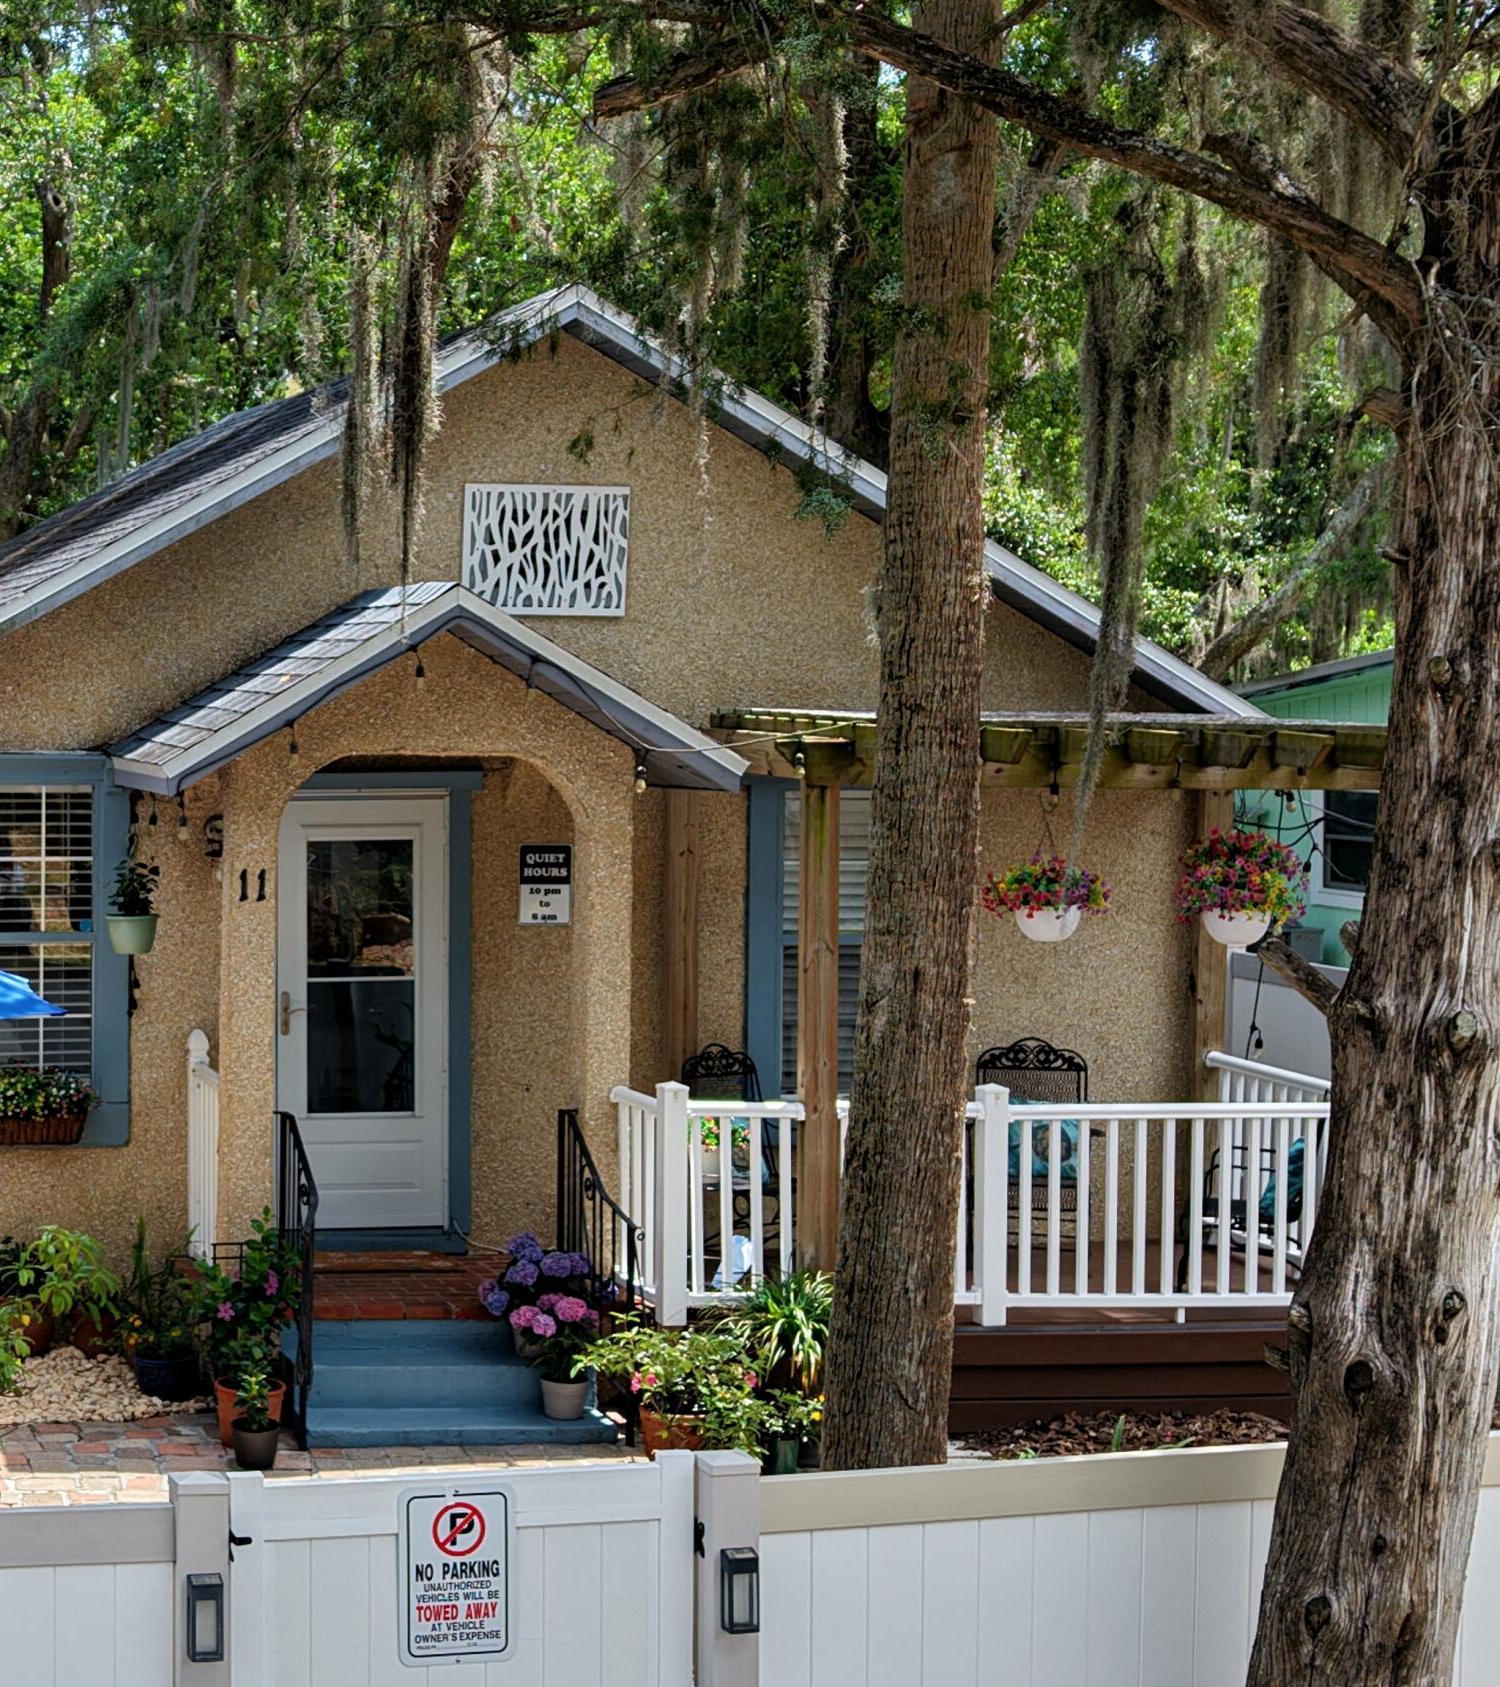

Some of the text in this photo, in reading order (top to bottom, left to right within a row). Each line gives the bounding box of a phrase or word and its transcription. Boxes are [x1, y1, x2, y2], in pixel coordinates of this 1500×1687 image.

[526, 854, 566, 864] QUIET
[524, 868, 567, 876] HOURS
[239, 868, 266, 902] 11
[544, 888, 561, 896] pm
[415, 1559, 500, 1582] NO PARKING
[423, 1580, 492, 1592] UNAUTHORIZED
[416, 1589, 500, 1603] VEHICLES WILL BE
[416, 1601, 498, 1623] TOWED AWAY
[431, 1620, 485, 1633] AT VEHICLE
[414, 1630, 501, 1644] OWNER'S EXPENSE
